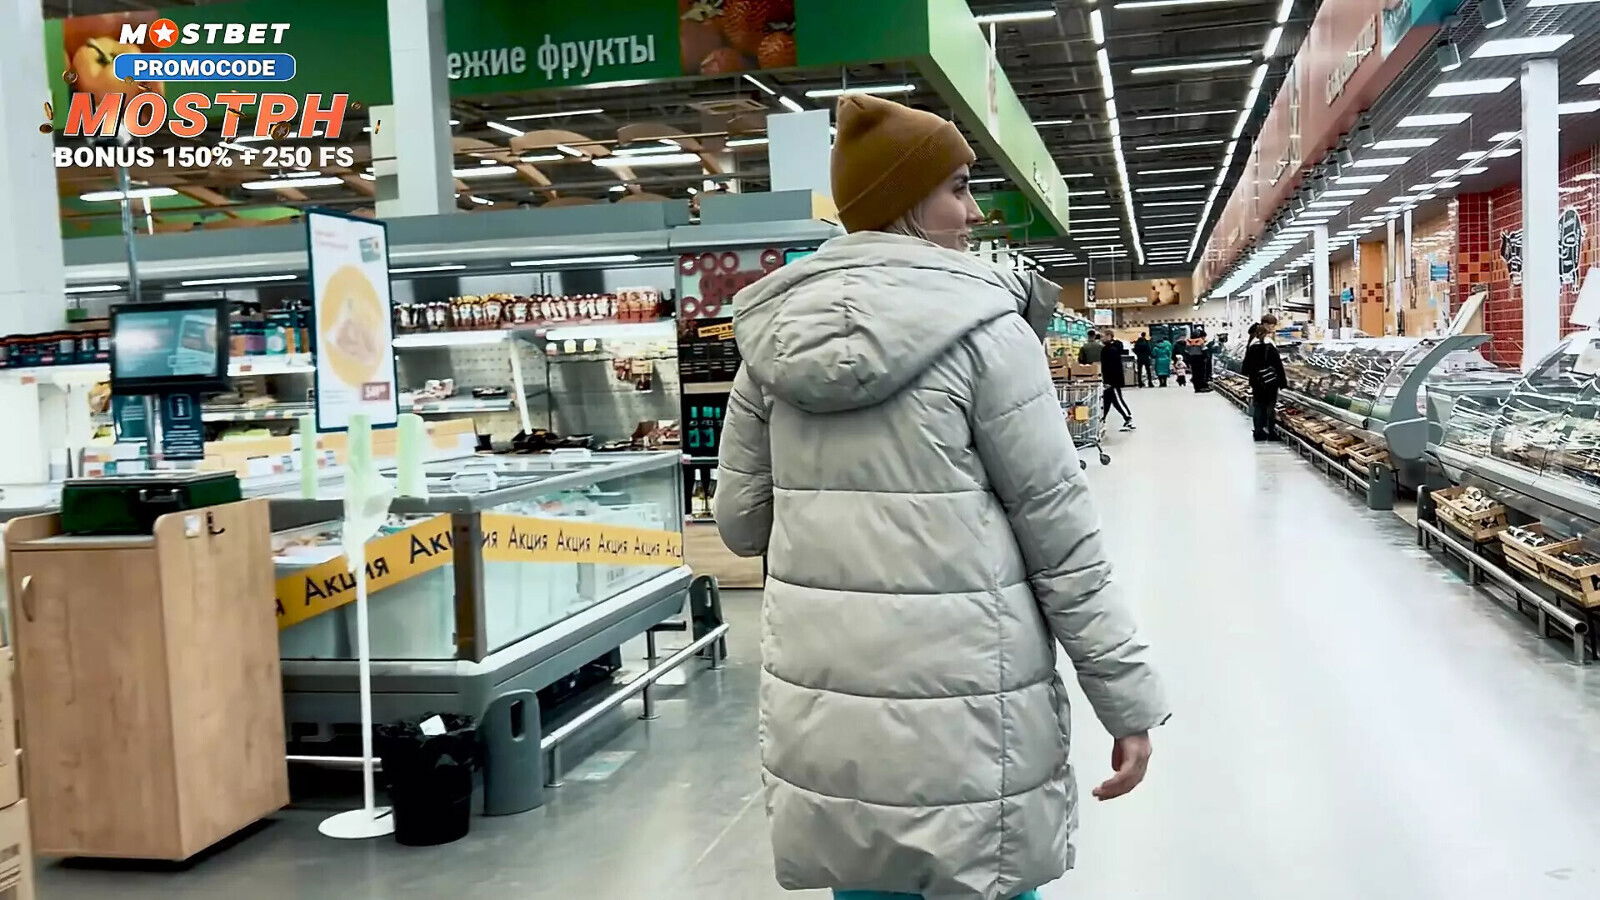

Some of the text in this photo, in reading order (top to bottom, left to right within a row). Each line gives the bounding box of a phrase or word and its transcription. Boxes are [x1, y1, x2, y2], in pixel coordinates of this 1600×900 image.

[447, 34, 655, 81] ежие фрукты
[508, 525, 548, 552] Акция
[556, 529, 591, 554] Акция
[598, 532, 628, 555] Акция
[634, 535, 661, 556] Акция
[666, 538, 683, 558] Акц
